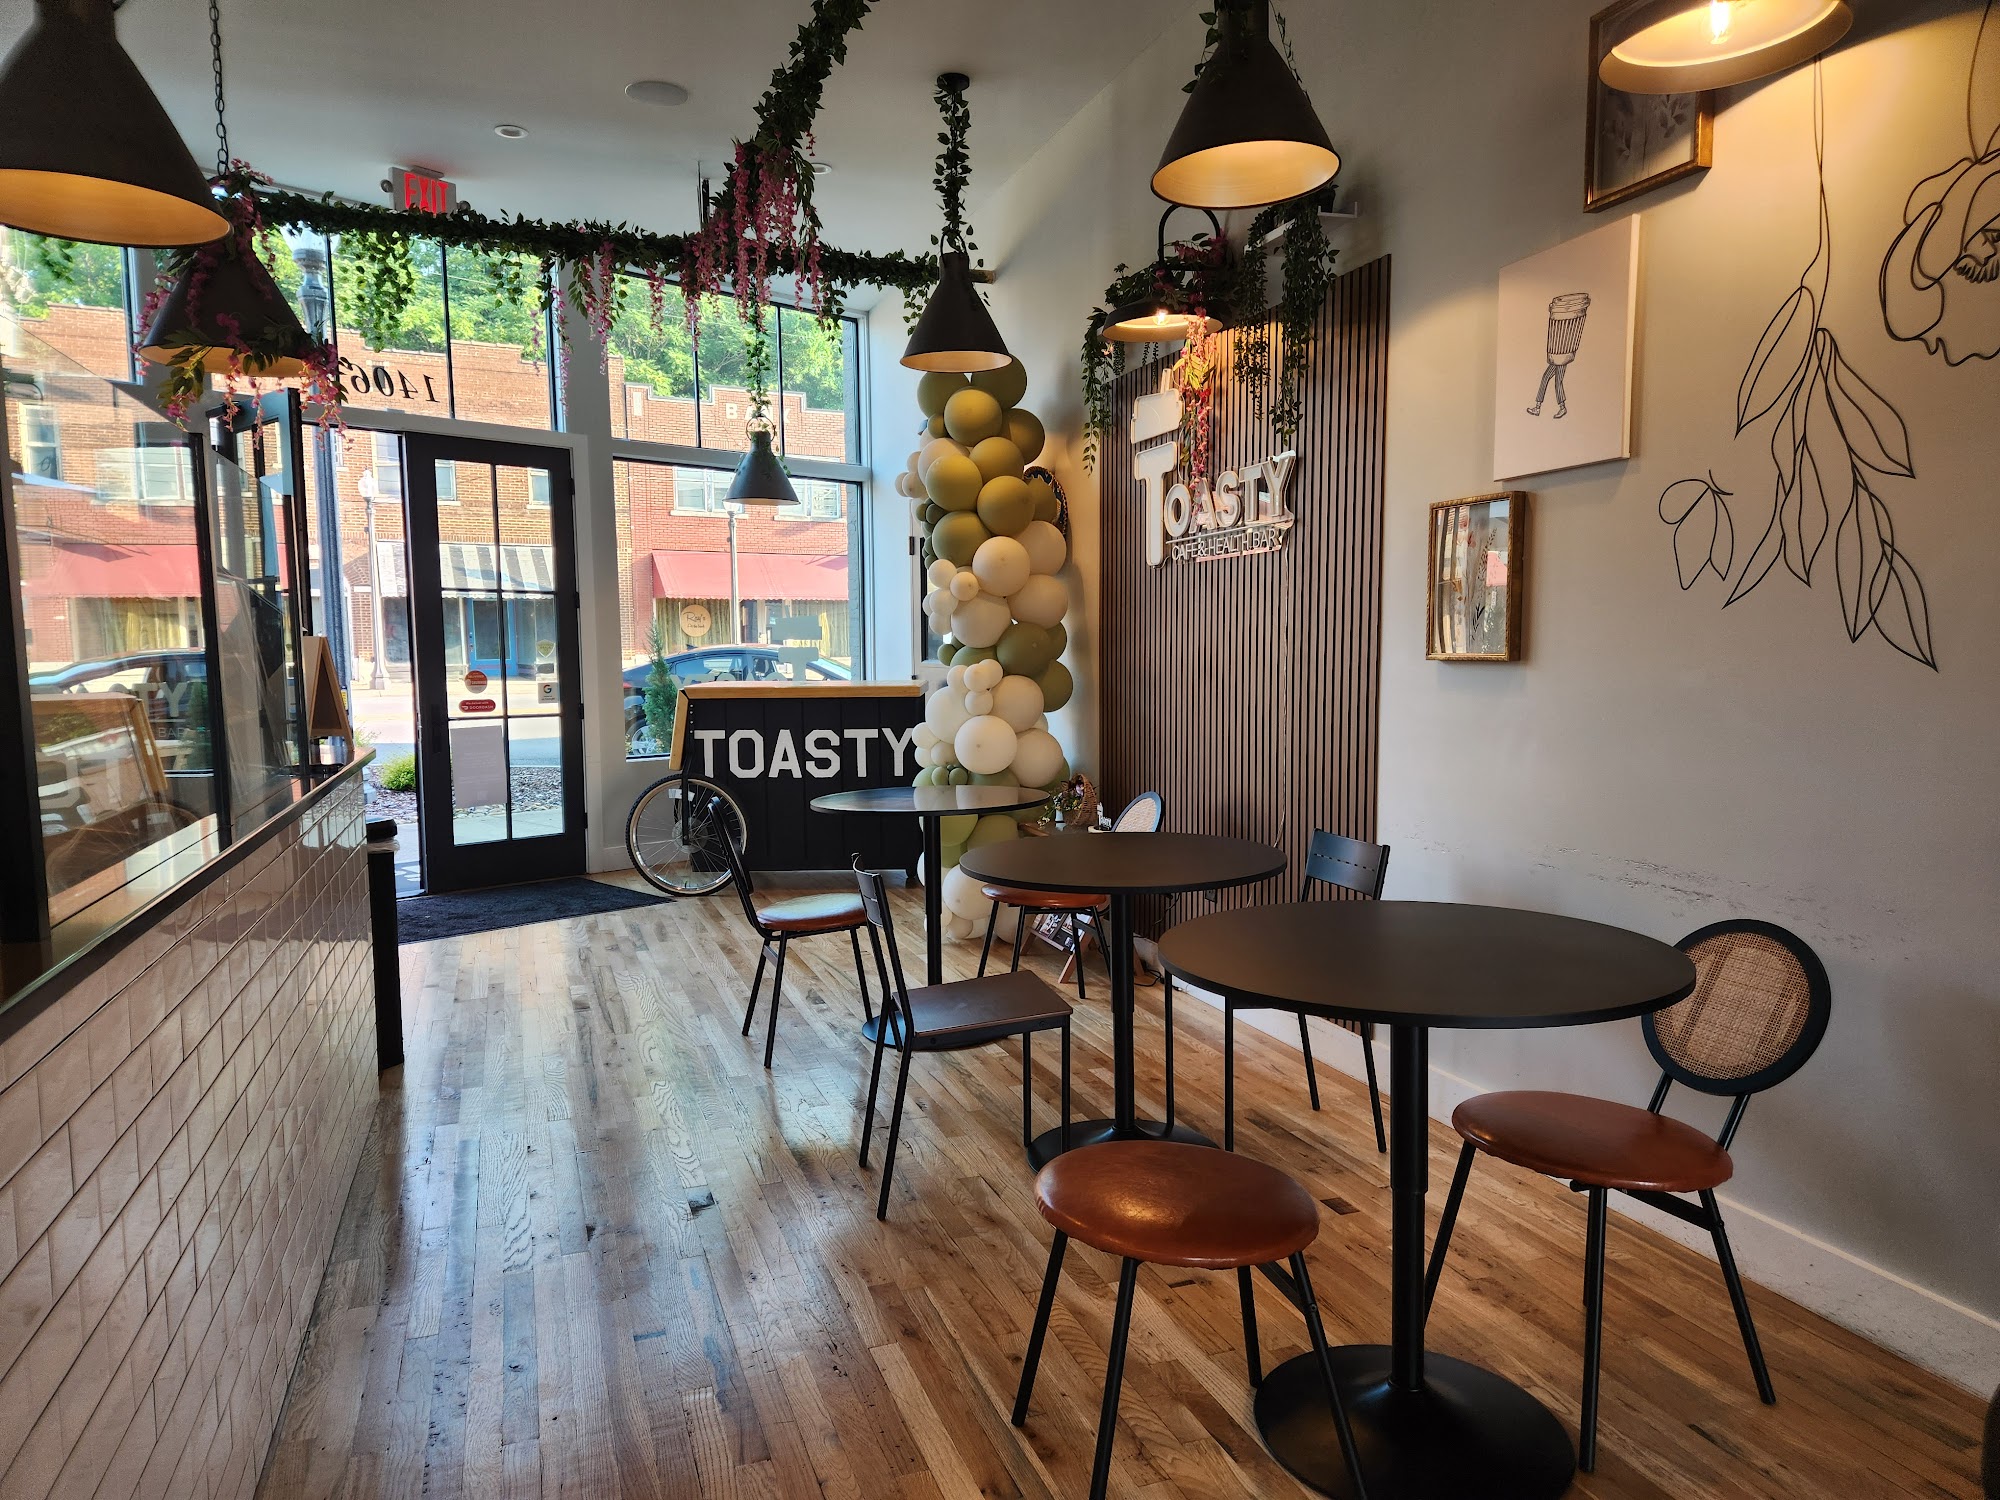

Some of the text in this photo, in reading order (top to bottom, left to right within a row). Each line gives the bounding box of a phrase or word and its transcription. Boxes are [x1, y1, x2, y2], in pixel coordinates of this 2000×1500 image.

[404, 172, 449, 213] EXIT
[1134, 440, 1297, 567] TOASTY
[1252, 528, 1278, 551] BAR
[693, 728, 914, 779] TOASTY
